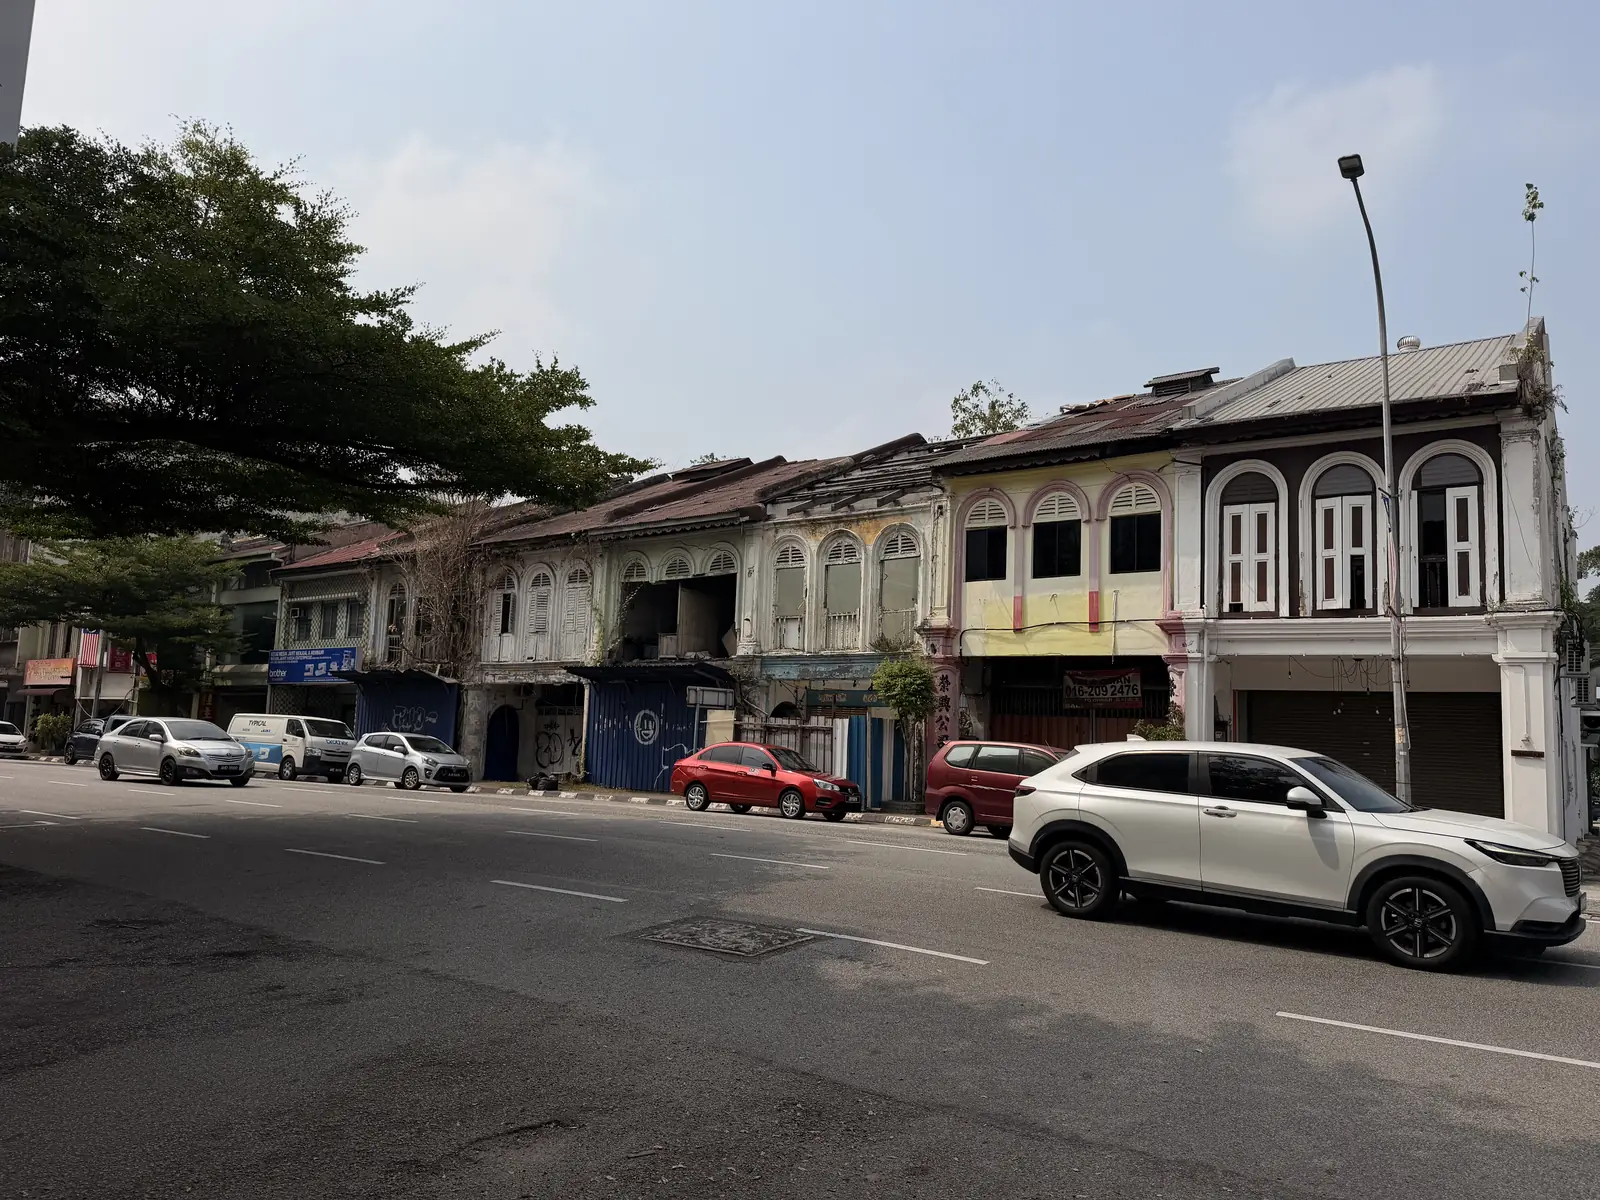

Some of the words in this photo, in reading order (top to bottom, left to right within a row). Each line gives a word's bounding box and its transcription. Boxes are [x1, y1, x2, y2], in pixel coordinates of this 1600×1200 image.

[269, 668, 287, 678] brother
[1065, 685, 1108, 697] 016-209
[1110, 683, 1139, 697] 2476
